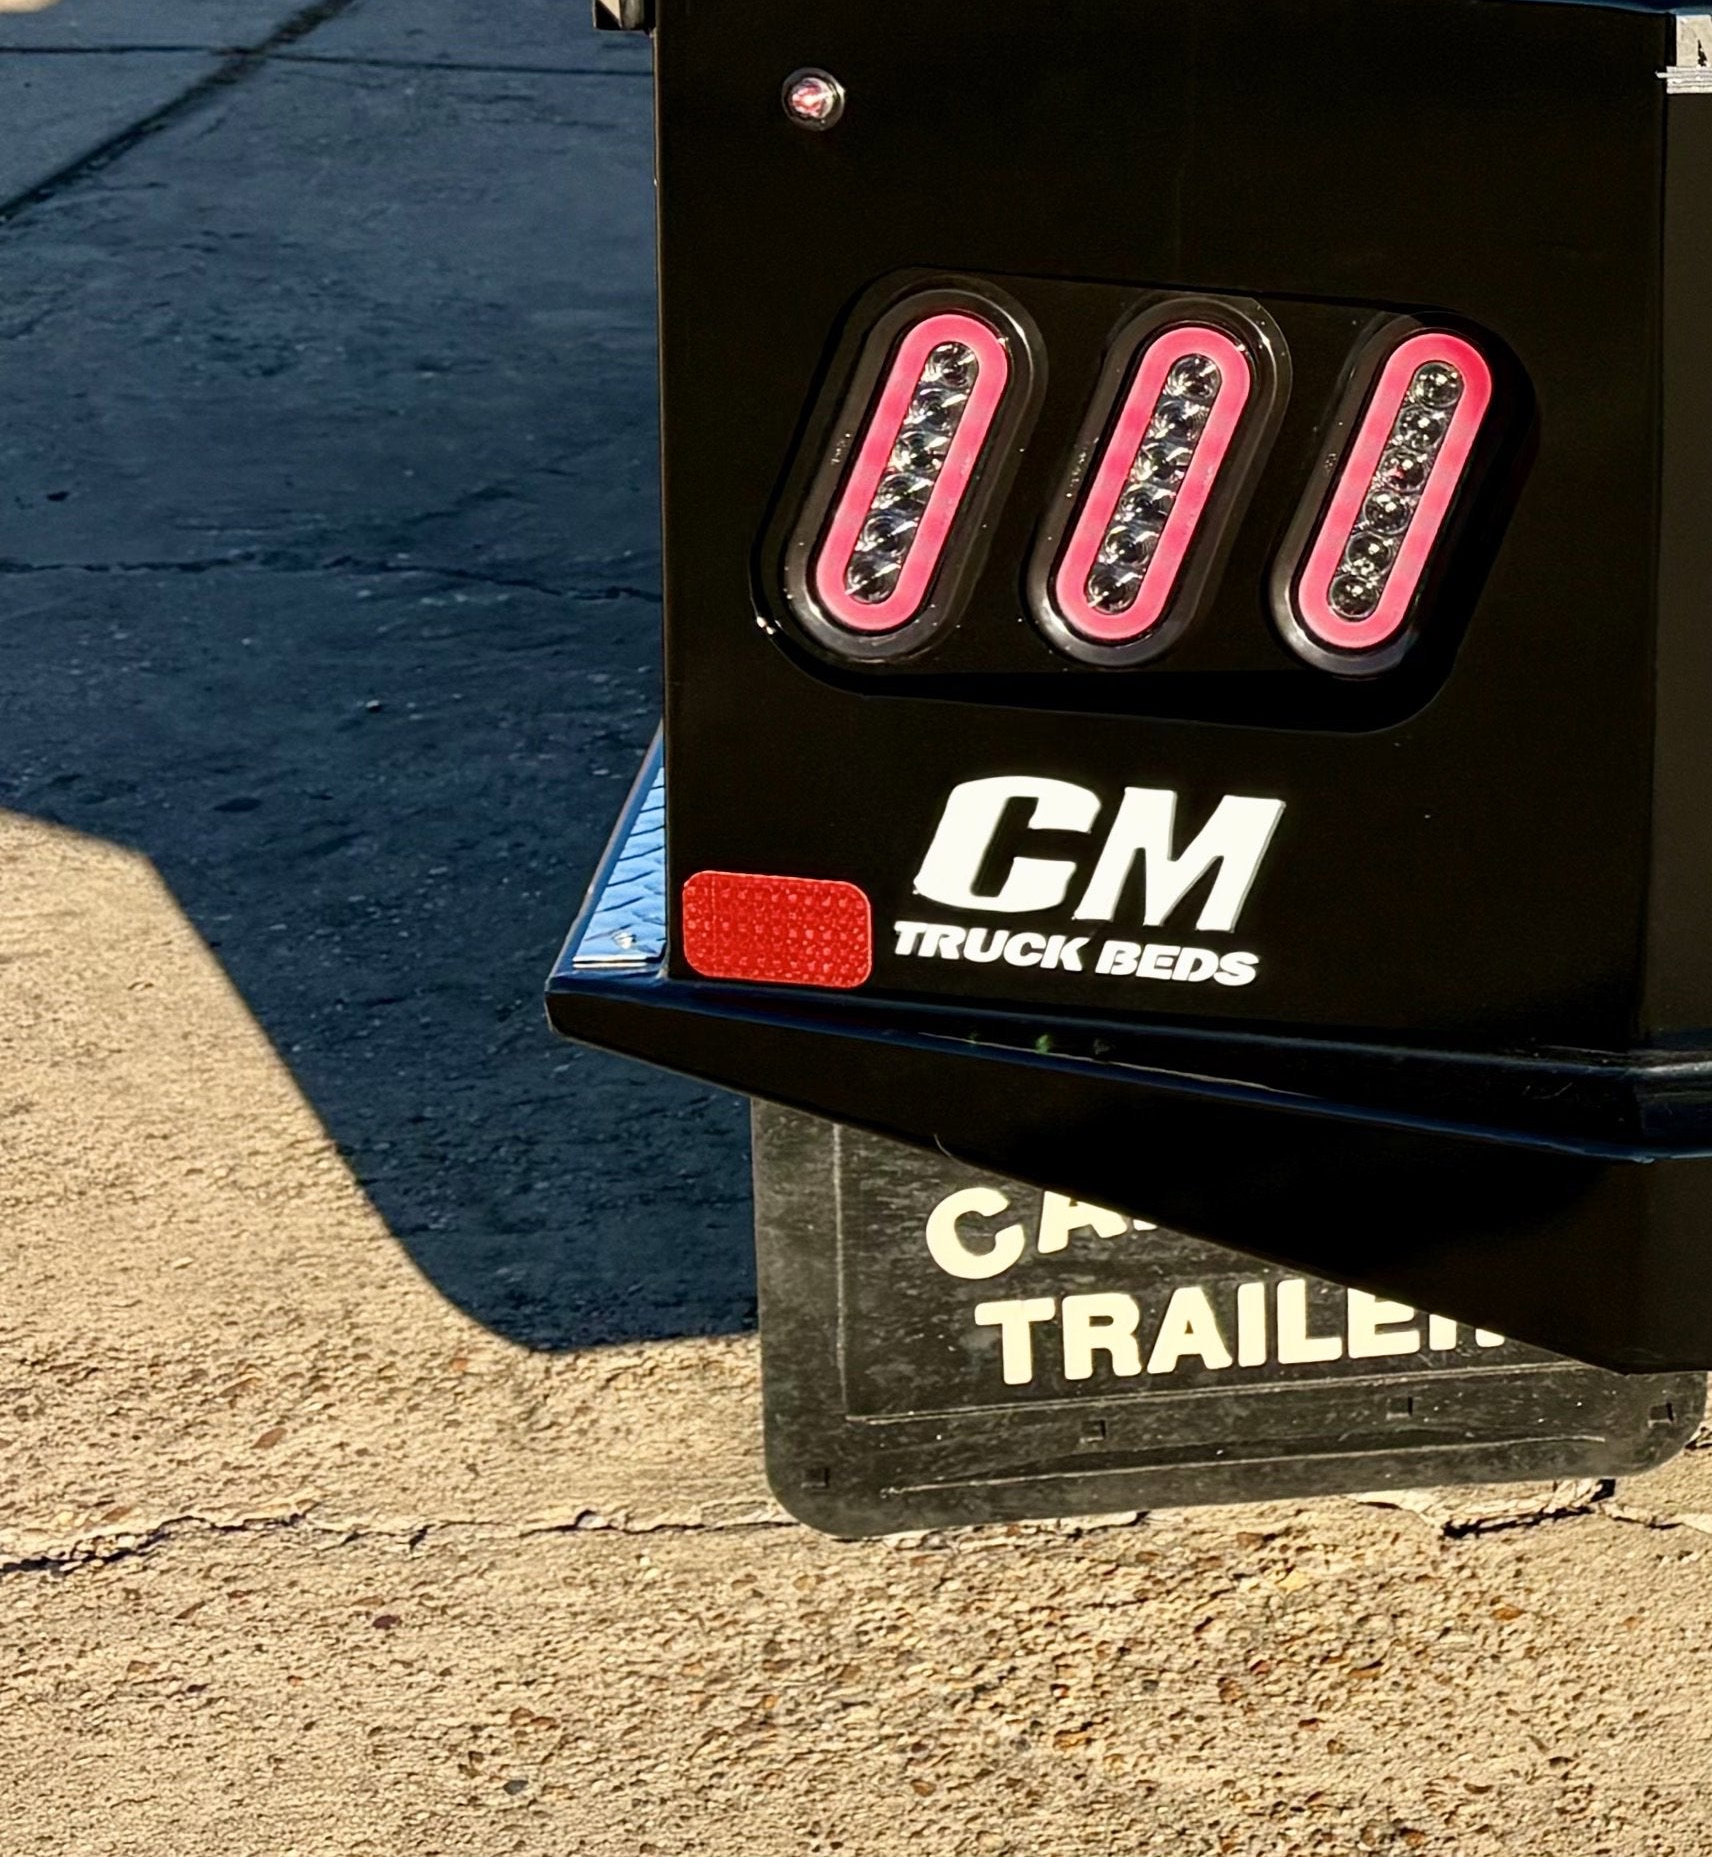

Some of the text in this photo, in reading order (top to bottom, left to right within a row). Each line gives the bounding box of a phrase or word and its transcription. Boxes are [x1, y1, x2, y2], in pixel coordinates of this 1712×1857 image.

[912, 775, 1287, 933] CM
[893, 920, 1261, 987] TRUCK BEDS
